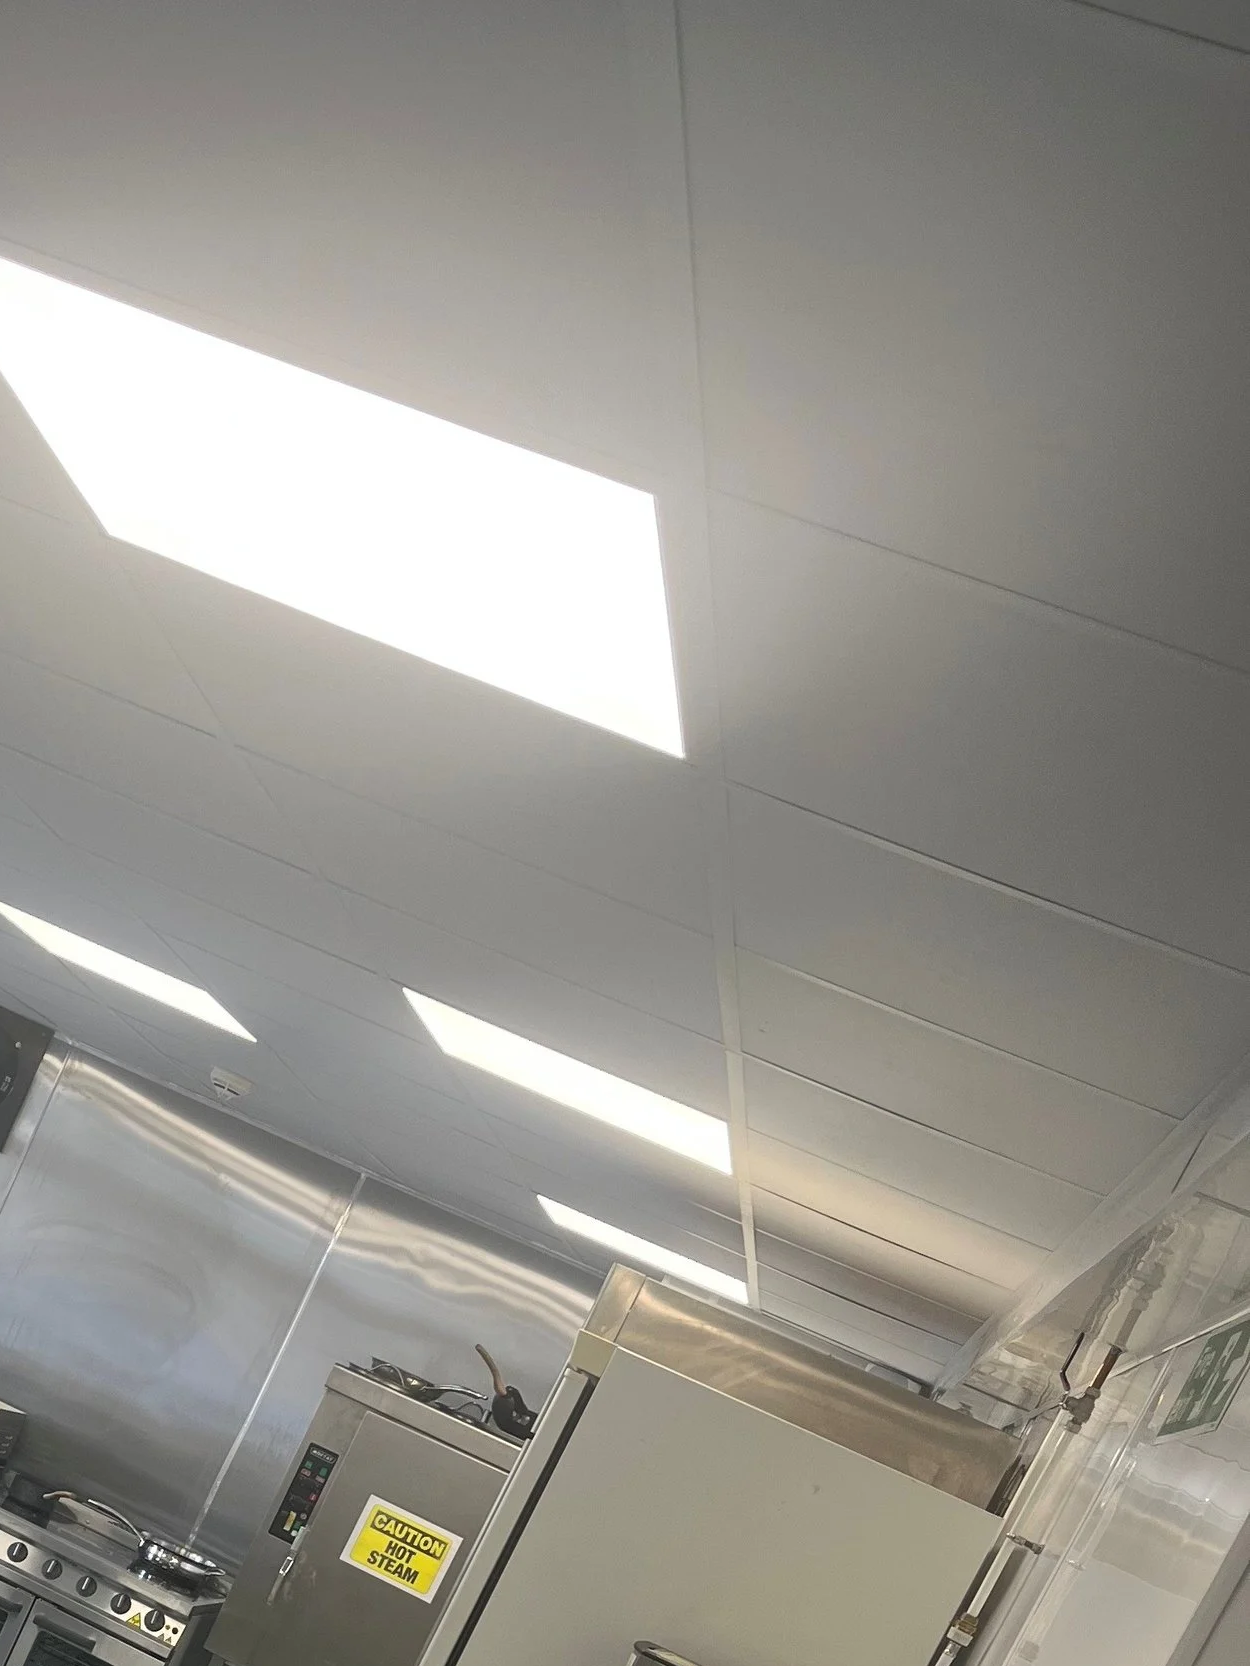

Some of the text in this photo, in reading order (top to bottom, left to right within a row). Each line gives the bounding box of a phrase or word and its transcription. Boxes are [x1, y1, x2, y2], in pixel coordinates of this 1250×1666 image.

[372, 1512, 445, 1557] CAUTION
[384, 1540, 416, 1564] HOT
[366, 1549, 419, 1584] STEAM
